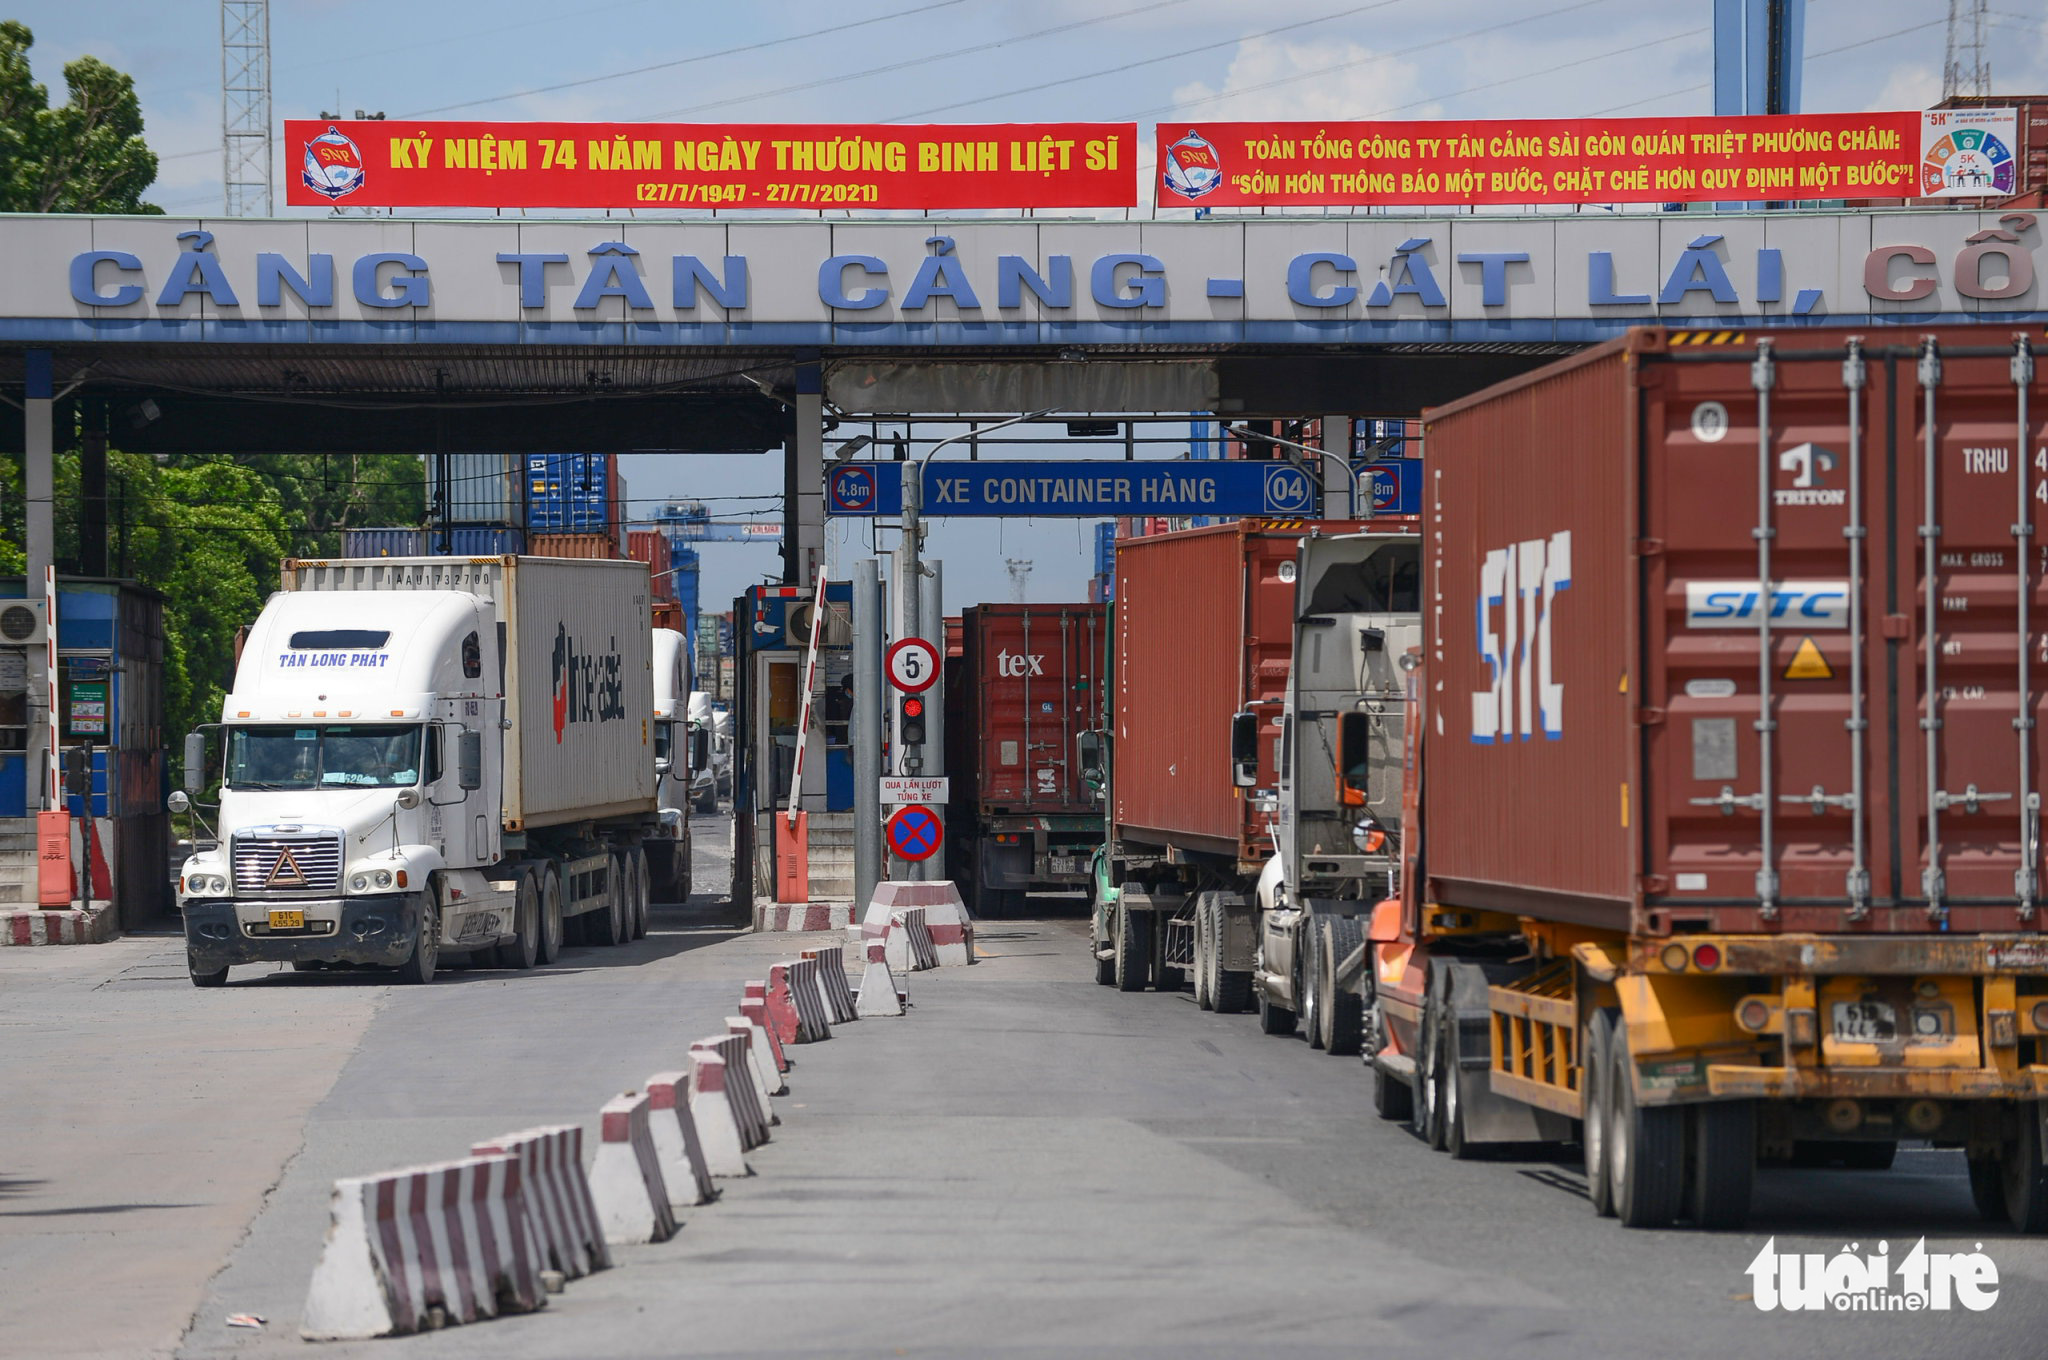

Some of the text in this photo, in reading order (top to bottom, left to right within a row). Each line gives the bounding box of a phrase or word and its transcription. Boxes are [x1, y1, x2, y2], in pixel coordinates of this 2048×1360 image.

[390, 131, 1118, 176] KỶ NIỆM 74 NĂM NGÀY THƯƠNG BINH LIỆT SĨ
[1245, 135, 1295, 159] TOÀN
[1301, 130, 1352, 159] TỔNG
[1358, 134, 1410, 158] CÔNG
[1417, 139, 1440, 158] TY
[1446, 134, 1484, 157] TÂN
[1490, 130, 1542, 157] CẢNG
[1549, 132, 1579, 157] SÀI
[1585, 131, 1625, 156] GÒN
[1632, 130, 1684, 156] QUÁN
[1691, 129, 1746, 159] TRIỆT
[1753, 128, 1832, 153] PHƯƠNG
[1838, 125, 1900, 150] CHÂM:
[1232, 169, 1279, 194] “SỚM
[1286, 171, 1324, 193] HƠN
[1331, 169, 1395, 193] THÔNG
[1402, 168, 1439, 192] BÁO
[1446, 169, 1485, 198] MỘT
[1492, 167, 1547, 195] BƯỚC,
[1554, 167, 1605, 196] CHẶT
[1610, 165, 1648, 190] CHẼ
[1656, 166, 1695, 189] HƠN
[1702, 169, 1741, 190] QUY
[1746, 168, 1793, 193] ĐỊNH
[1800, 162, 1840, 191] MỘT
[1847, 160, 1914, 185] BƯỚC”!
[637, 183, 746, 203] (27/7/1947
[767, 183, 878, 203] 27/7/2021)
[70, 230, 430, 308] CẢNG
[496, 241, 748, 309] TÂN
[818, 235, 1165, 309] CẢNG
[1207, 279, 1243, 298] -
[1287, 237, 1530, 308] CÁT
[1864, 213, 2036, 300] CỔ
[1962, 448, 2008, 473] TRHU
[837, 480, 870, 496] 4.8m
[936, 472, 1216, 503] XE CONTAINER HÀNG
[1273, 477, 1303, 501] 04
[1773, 489, 1846, 505] TRITON
[1691, 592, 1845, 618] SITC
[311, 654, 347, 666] LONG
[350, 651, 389, 667] PHÁT
[906, 653, 919, 679] 5
[997, 648, 1045, 677] tex
[1042, 702, 1052, 710] GL
[885, 781, 900, 789] QUA
[921, 793, 932, 801] XE
[278, 911, 293, 920] 61C
